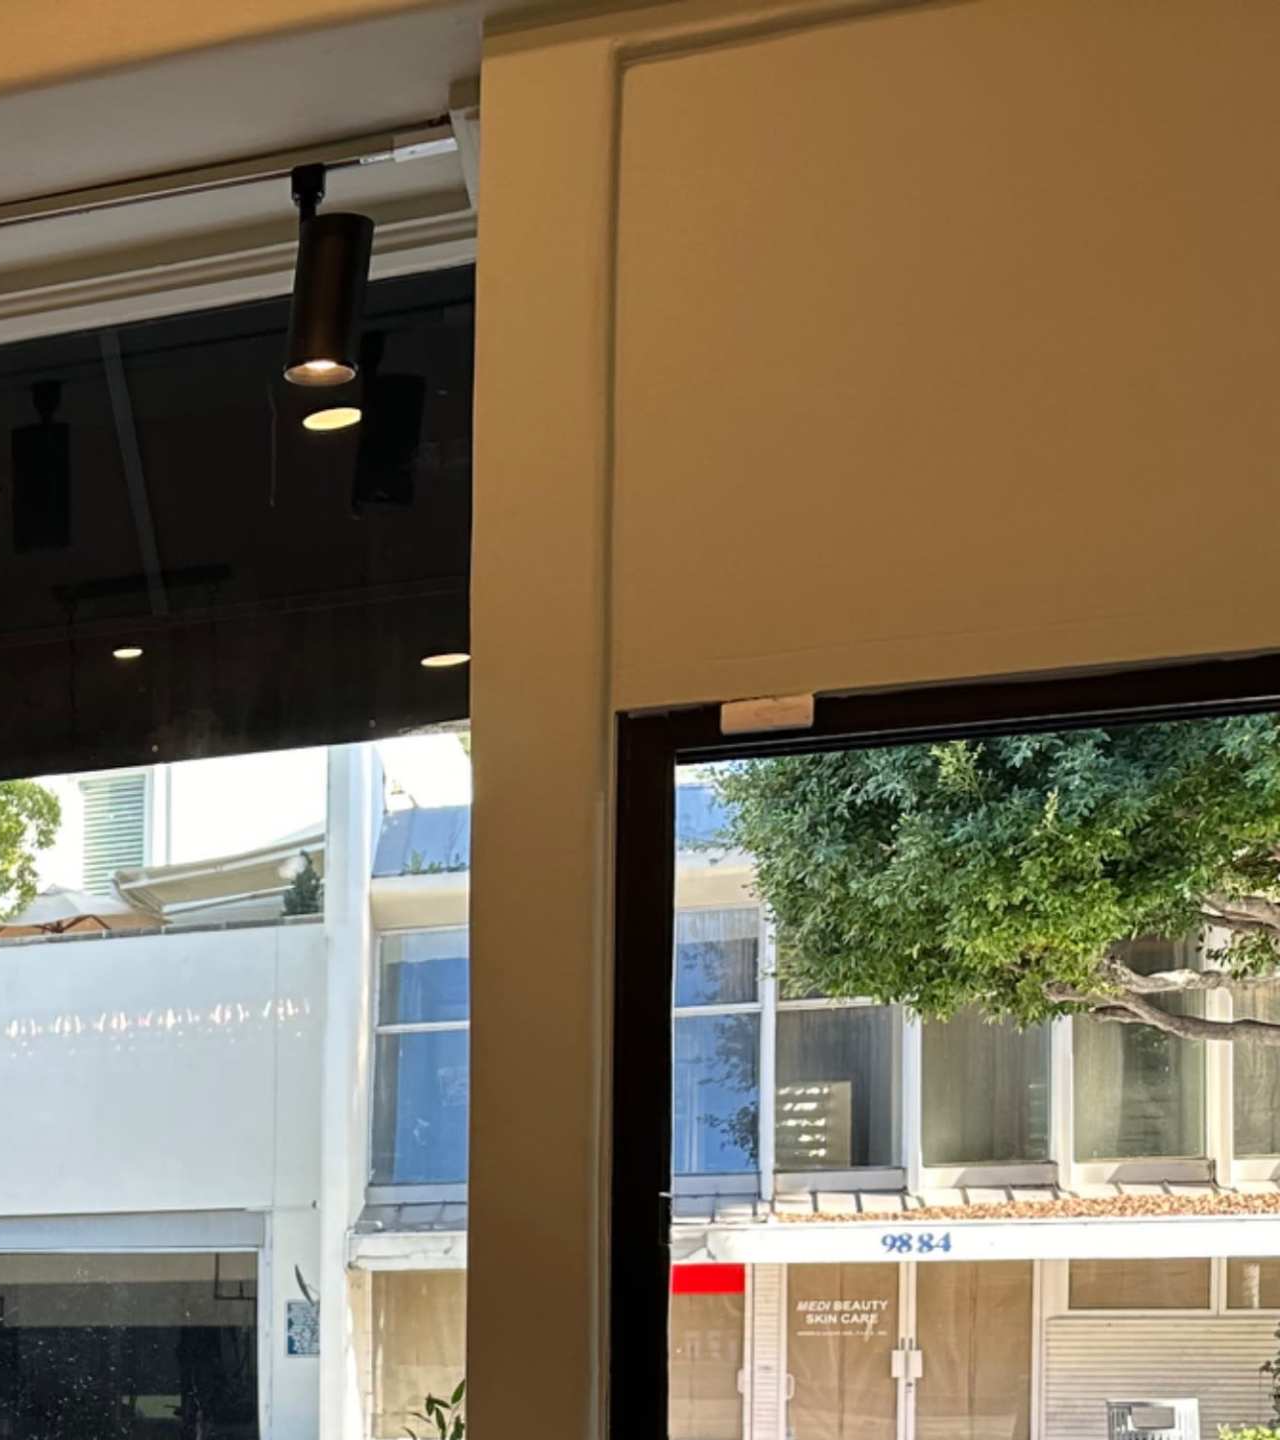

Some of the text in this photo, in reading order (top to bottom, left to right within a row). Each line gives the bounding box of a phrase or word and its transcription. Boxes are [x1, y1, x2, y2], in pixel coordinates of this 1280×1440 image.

[880, 1231, 952, 1254] 9884
[796, 1300, 888, 1311] MEDI BEAUTY
[806, 1313, 878, 1324] SKIN CARE
